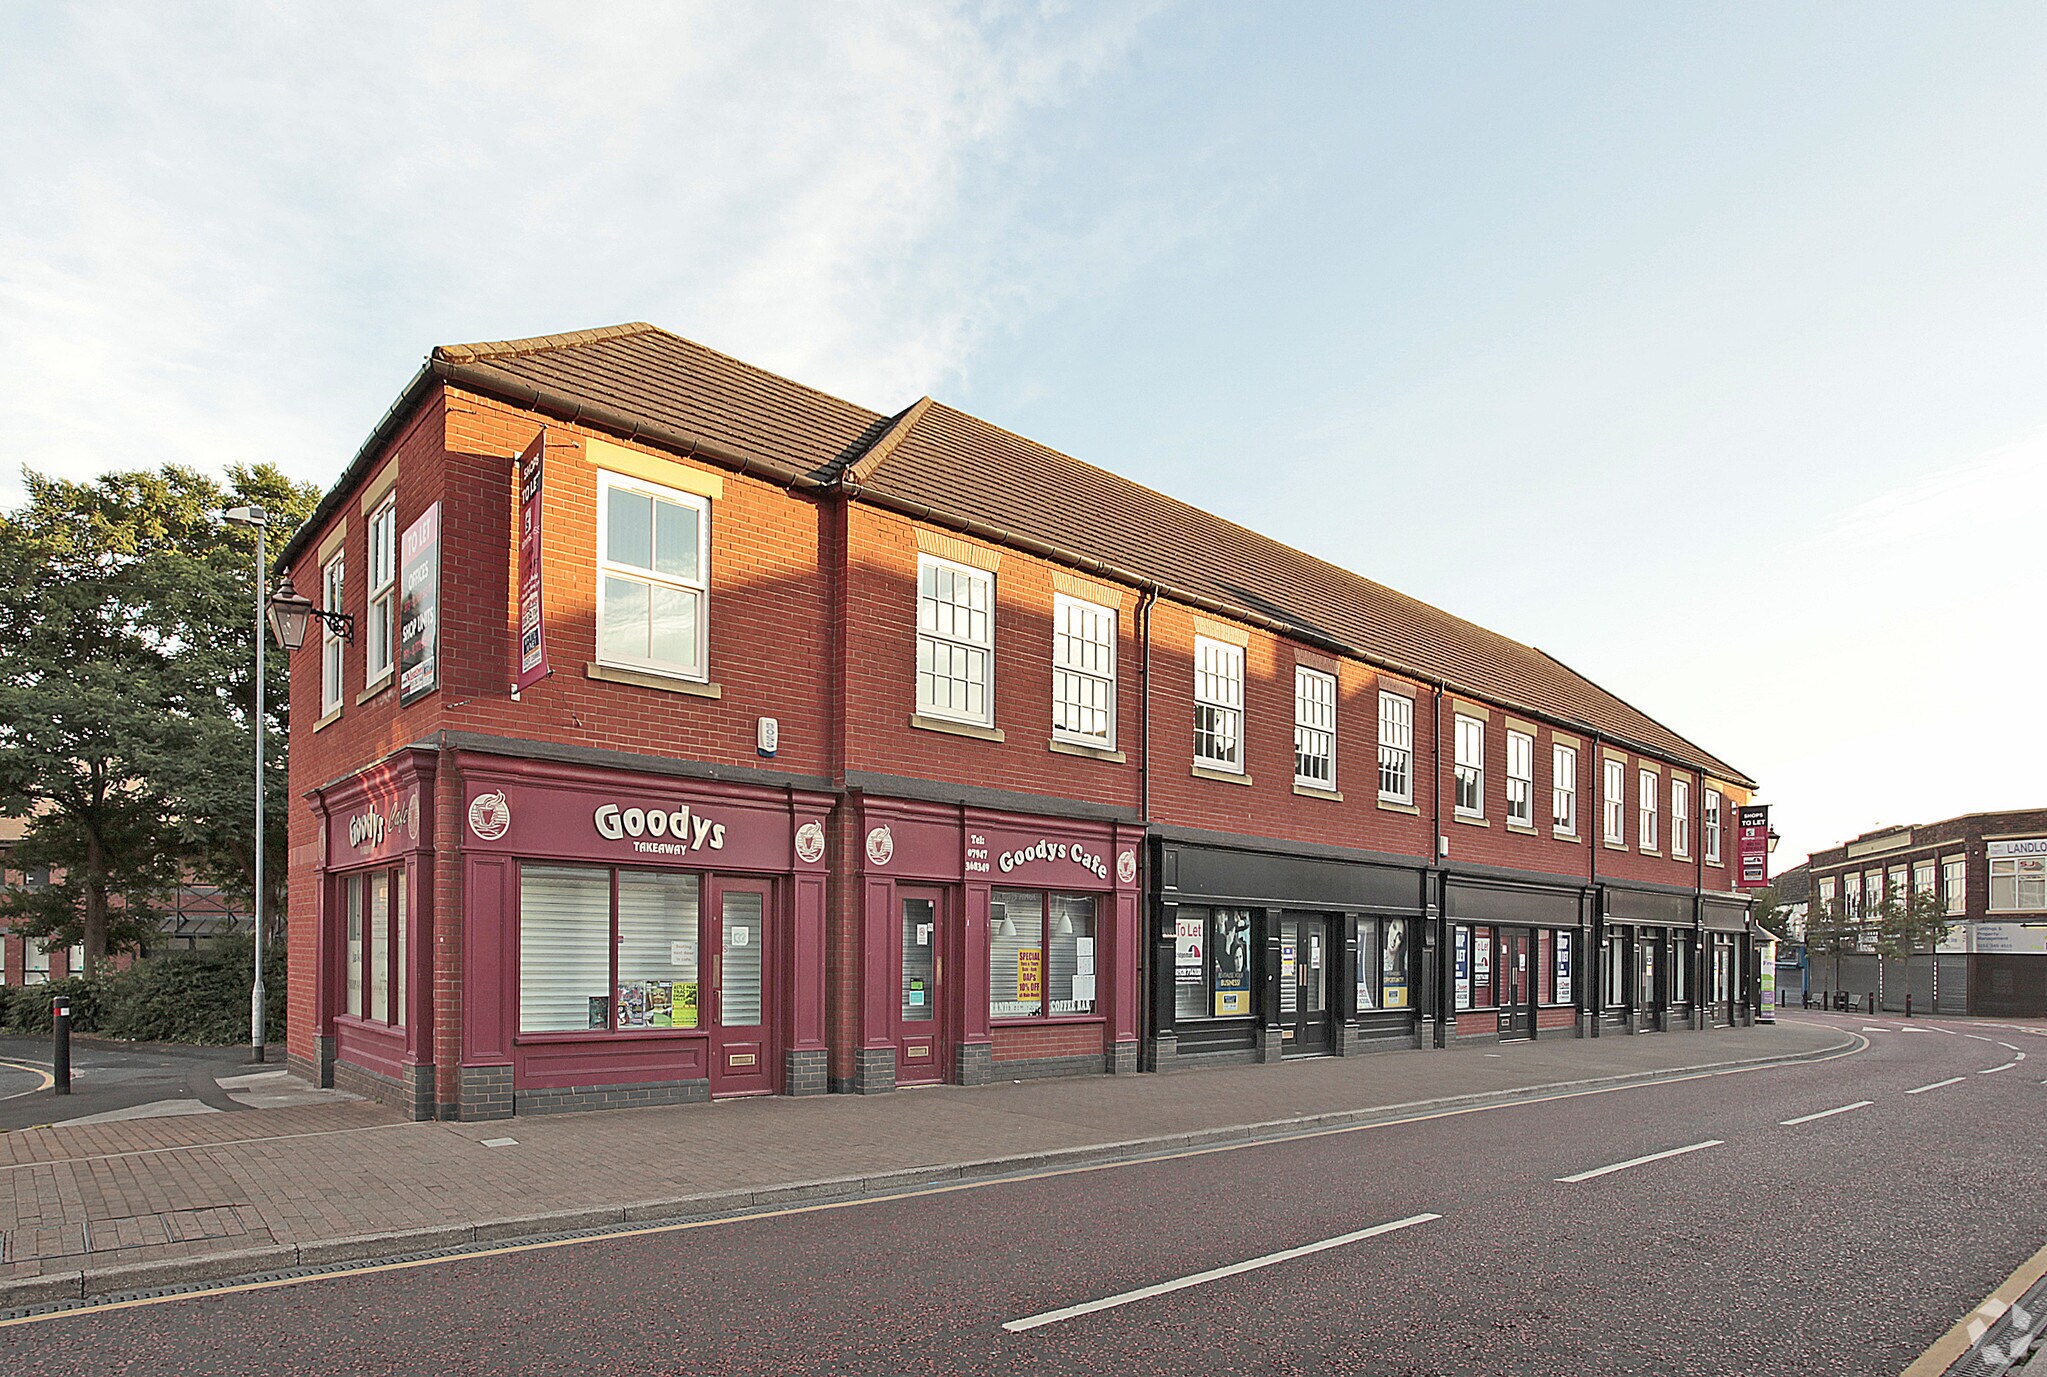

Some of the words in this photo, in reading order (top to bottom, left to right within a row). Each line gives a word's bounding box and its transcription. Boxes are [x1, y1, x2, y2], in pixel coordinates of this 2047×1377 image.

[524, 453, 540, 480] SHOPS
[522, 485, 529, 504] TO
[408, 530, 418, 556] TO
[419, 516, 431, 546] LET
[408, 560, 429, 591] OFFICES
[403, 618, 417, 643] SHOP
[418, 606, 433, 632] UNITS
[350, 804, 385, 848] Goodys
[388, 802, 408, 834] Cafe
[594, 803, 726, 851] Goodys
[633, 841, 687, 856] TAKEAWAY
[999, 839, 1066, 873] Goodys
[1070, 844, 1108, 879] Cafe
[1176, 923, 1186, 937] To
[1188, 922, 1201, 937] Let
[1020, 952, 1040, 960] SPECIAL
[1019, 983, 1029, 991] 10%
[1050, 1000, 1075, 1012] COFFEE
